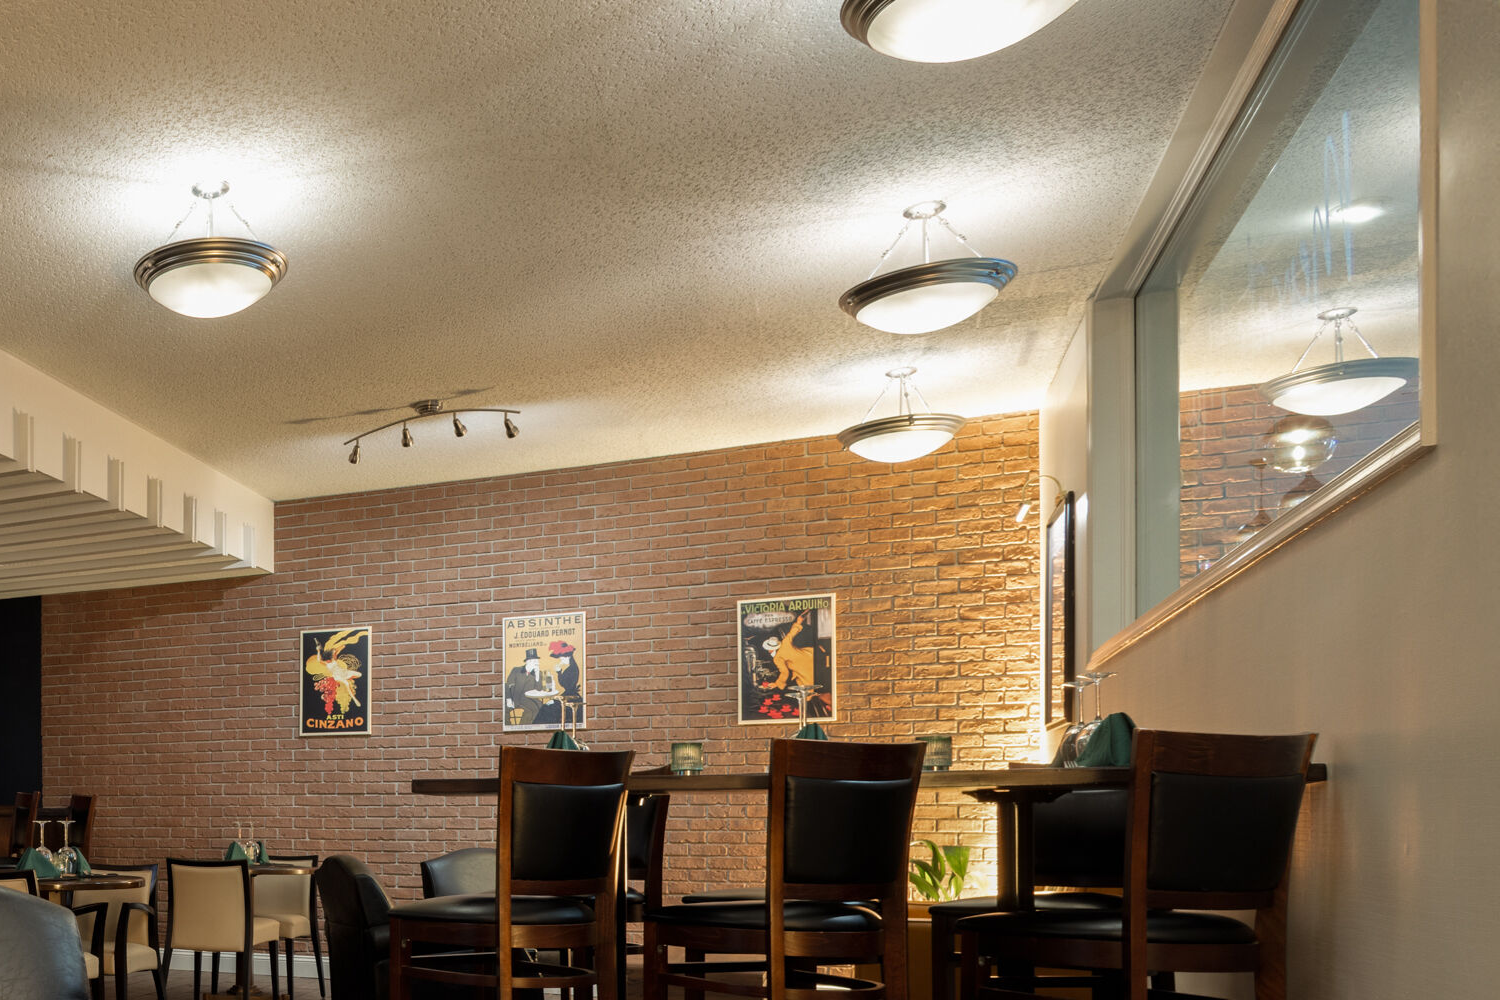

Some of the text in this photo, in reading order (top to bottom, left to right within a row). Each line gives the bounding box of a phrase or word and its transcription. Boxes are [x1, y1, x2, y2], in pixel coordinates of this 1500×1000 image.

[745, 602, 785, 614] VICTORIA
[788, 598, 829, 611] ARDUINO
[507, 615, 581, 629] ABSINTHE
[306, 717, 364, 728] CINZANO
